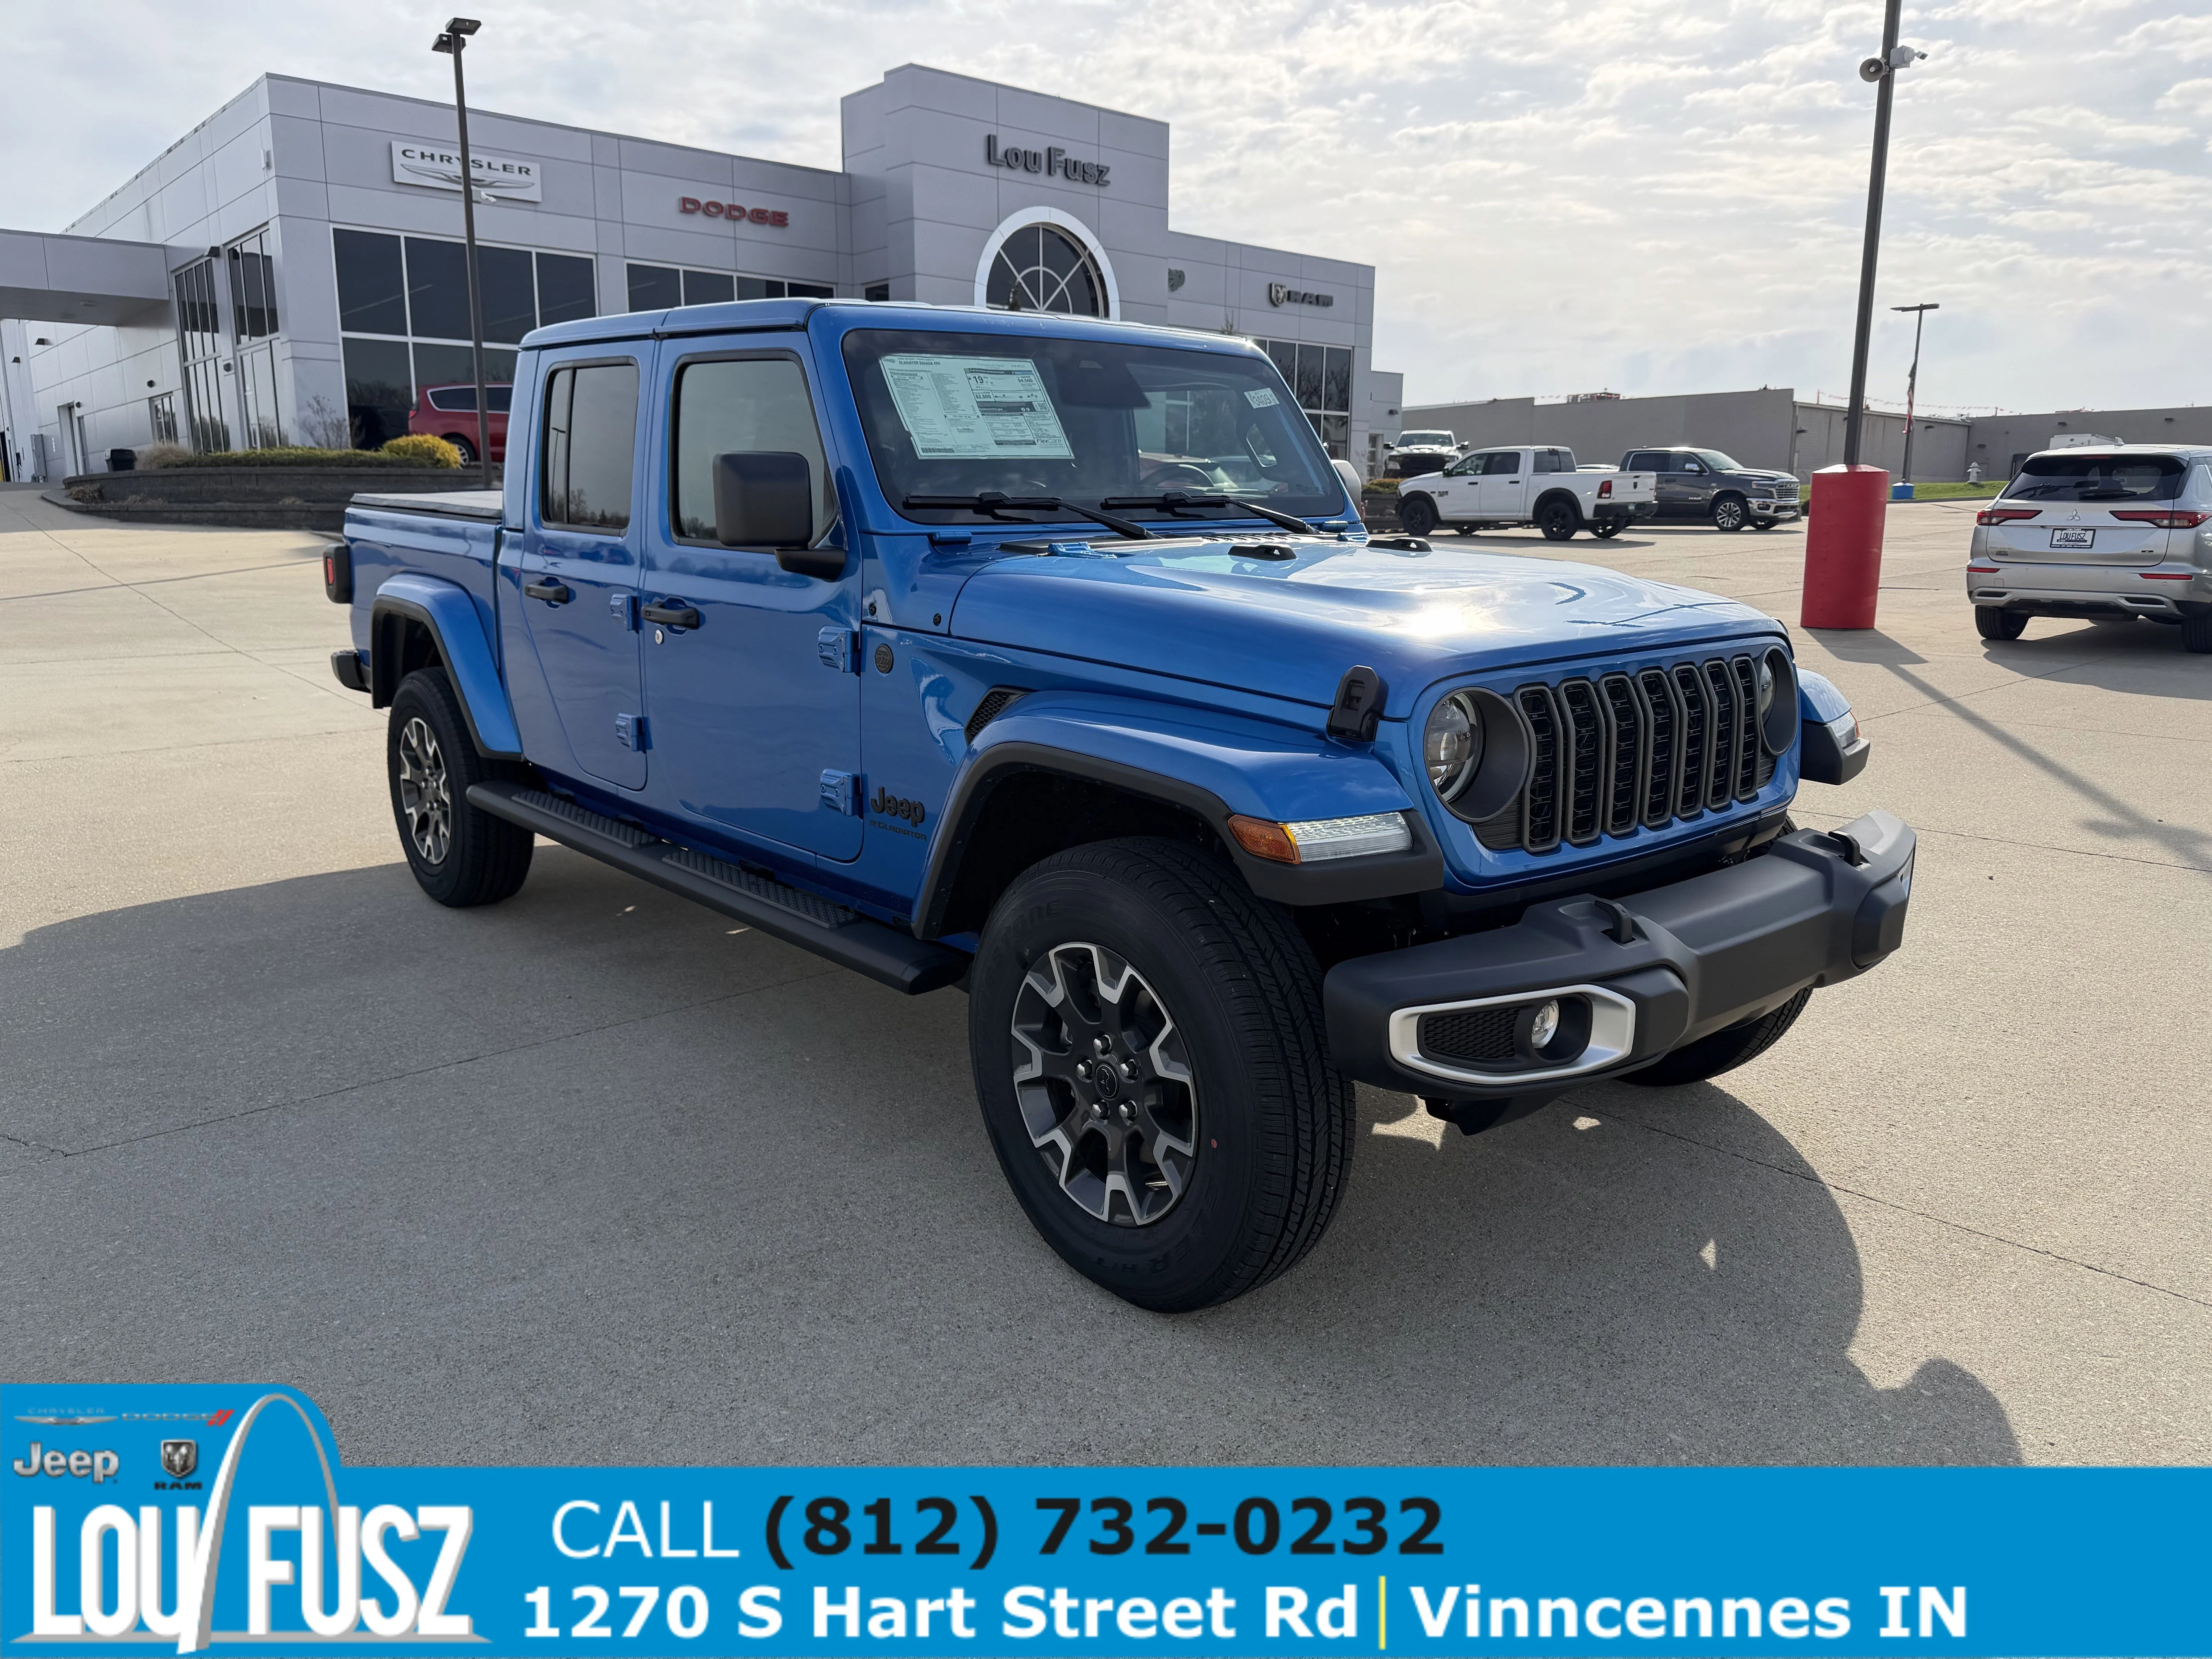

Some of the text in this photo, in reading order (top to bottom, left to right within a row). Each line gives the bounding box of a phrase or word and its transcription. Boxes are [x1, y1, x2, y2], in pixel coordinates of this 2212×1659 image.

[986, 134, 1111, 186] Lou Fusz
[680, 196, 789, 227] DODGE
[1286, 290, 1333, 307] RAM
[973, 376, 984, 384] 19
[1252, 394, 1272, 406] 3409
[870, 786, 925, 828] Jeep
[877, 821, 927, 842] GLADIATOR
